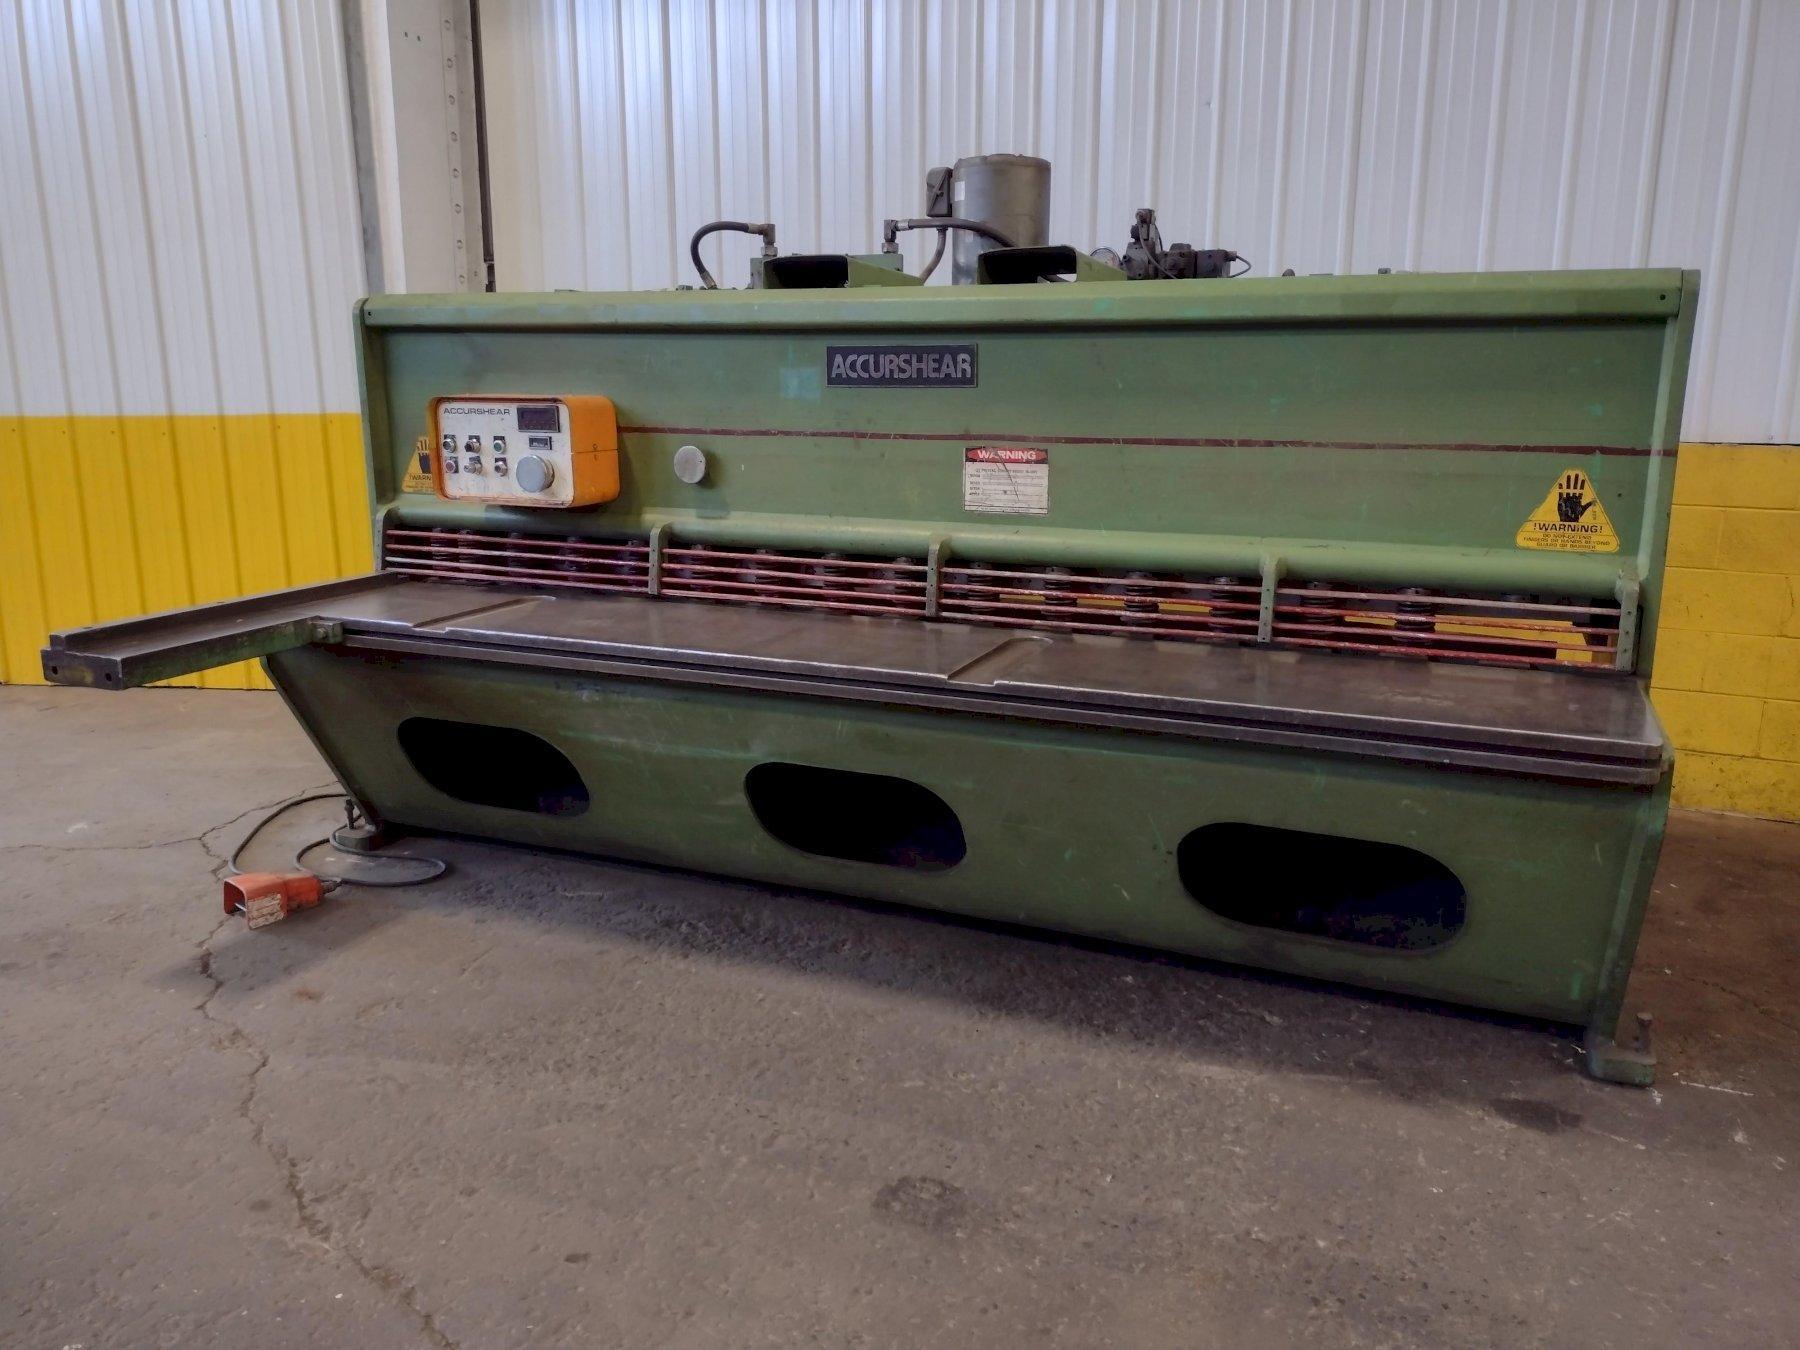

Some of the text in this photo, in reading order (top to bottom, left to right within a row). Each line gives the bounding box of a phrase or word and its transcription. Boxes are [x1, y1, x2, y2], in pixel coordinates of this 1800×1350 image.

[831, 353, 972, 378] ACCURSHEAR
[443, 407, 511, 416] ACCURSHEAR
[977, 450, 1037, 460] WARNING
